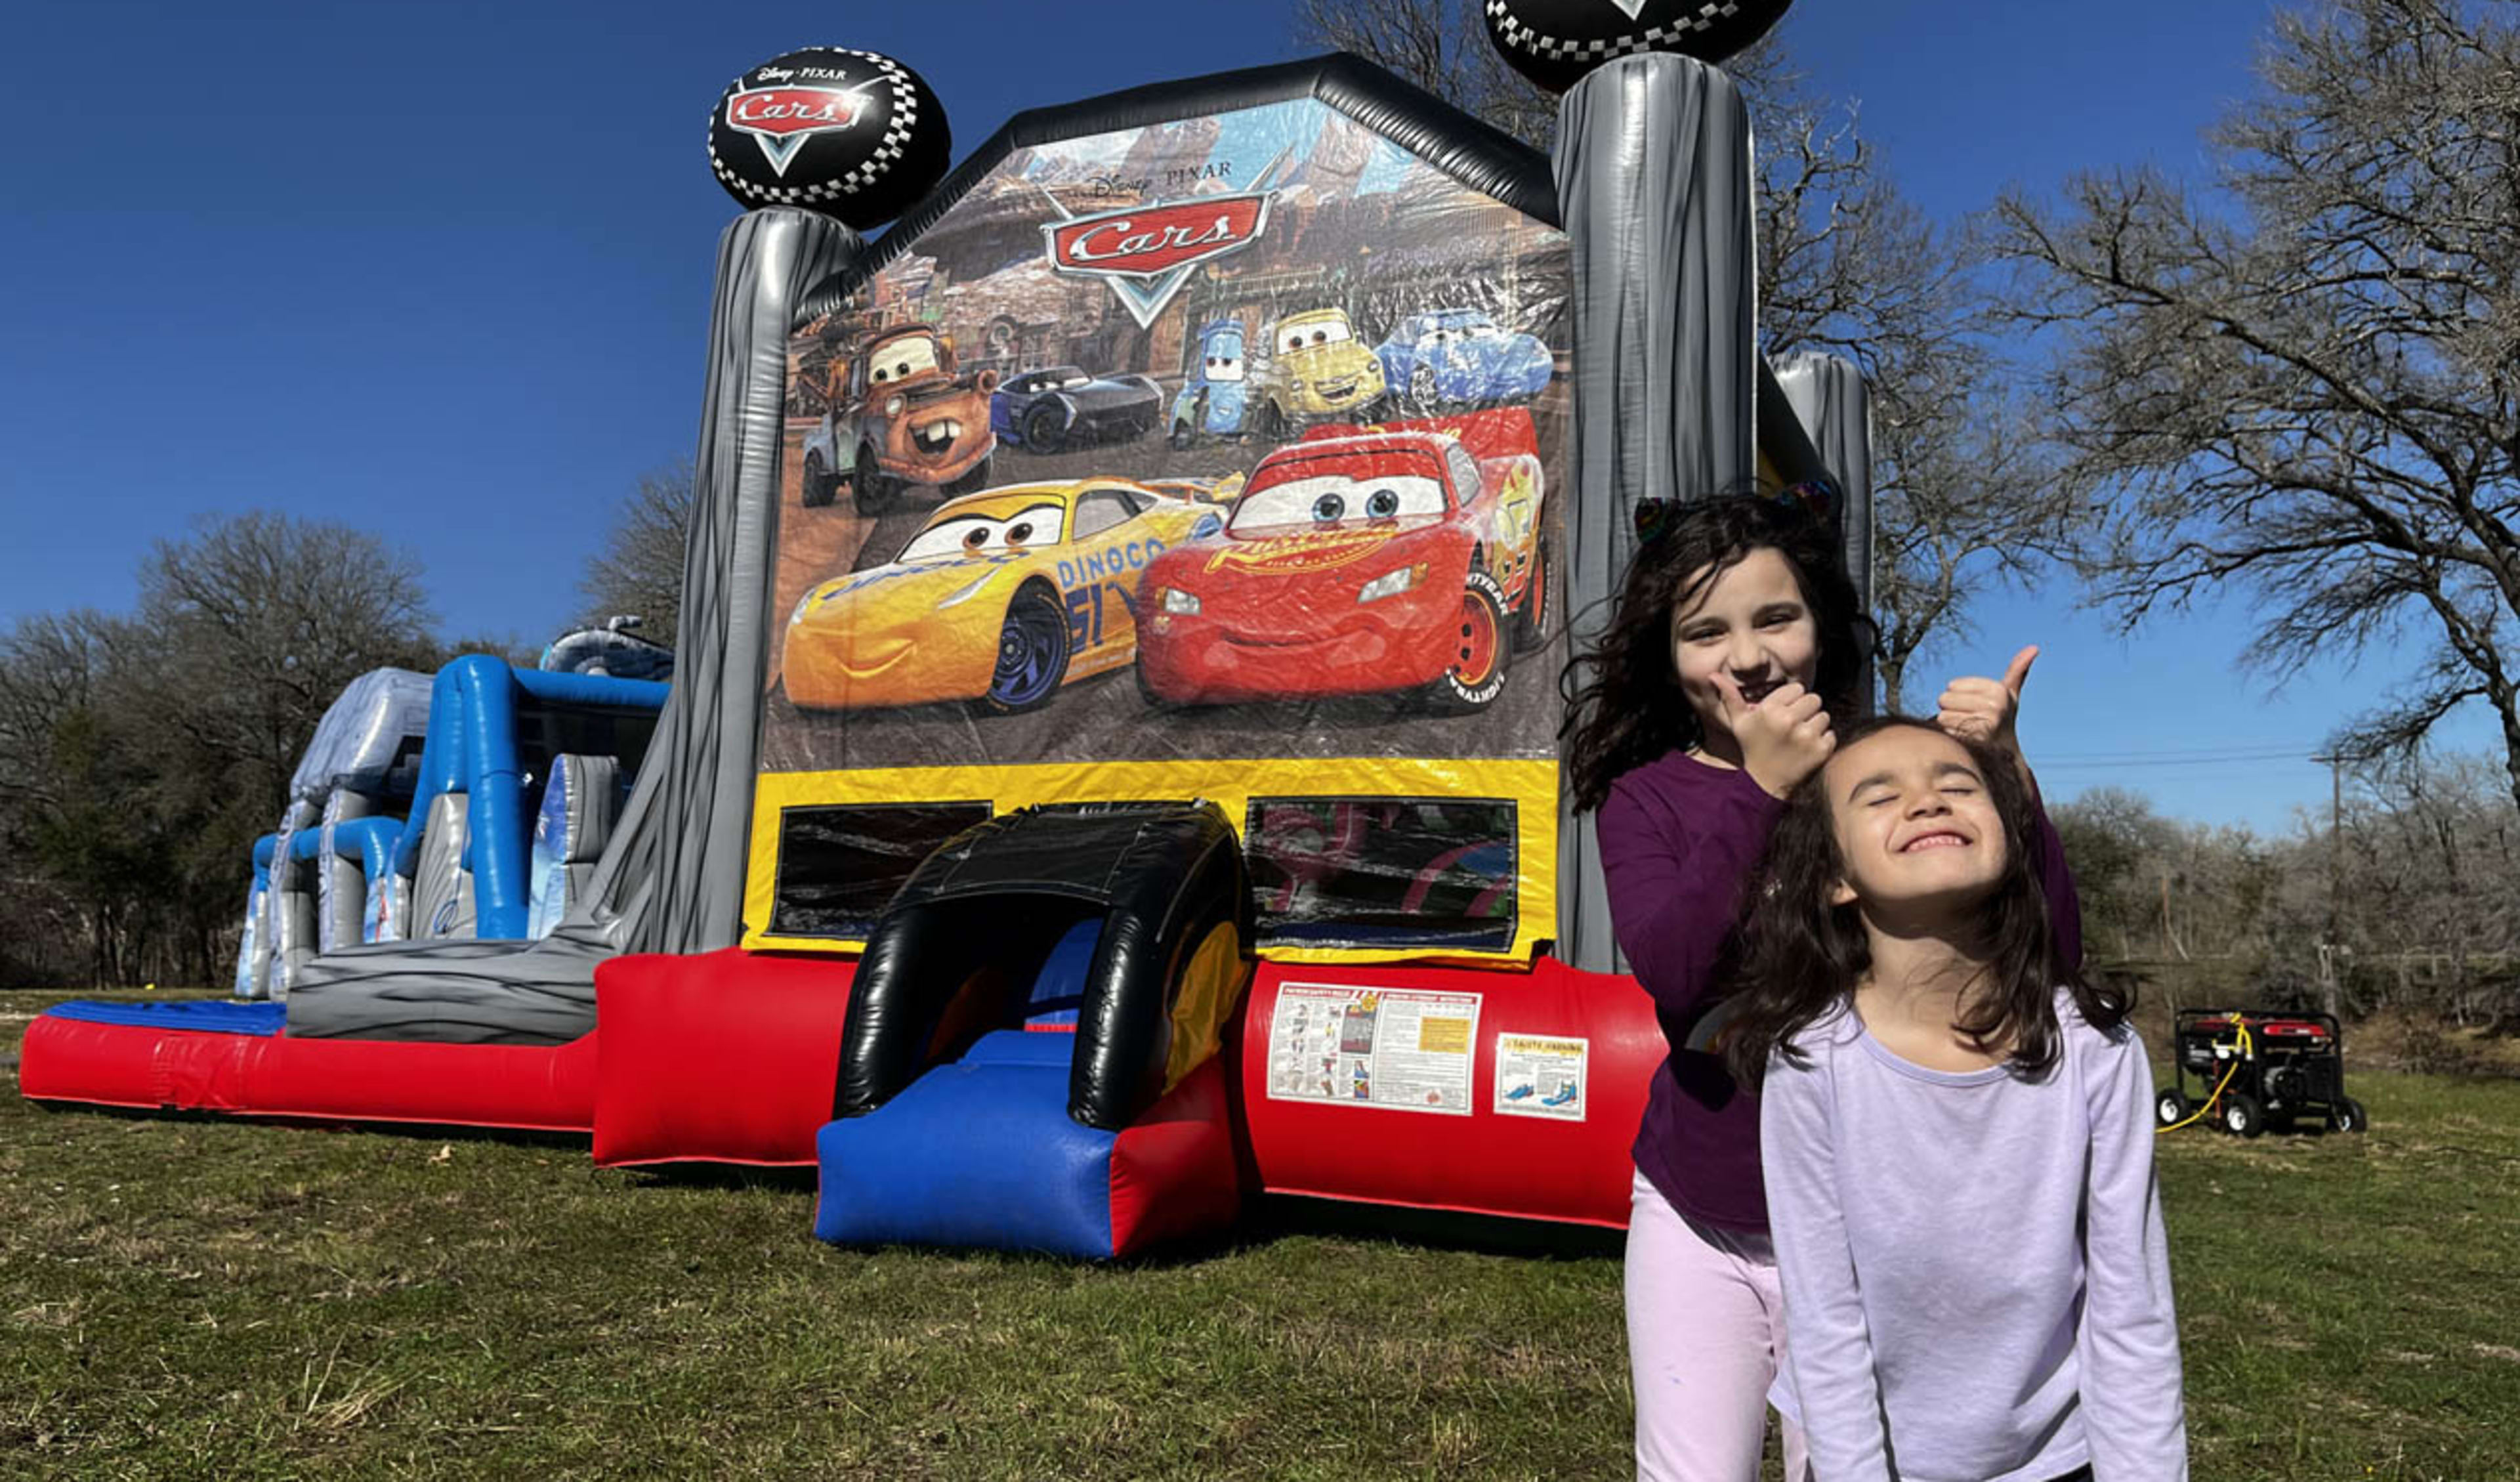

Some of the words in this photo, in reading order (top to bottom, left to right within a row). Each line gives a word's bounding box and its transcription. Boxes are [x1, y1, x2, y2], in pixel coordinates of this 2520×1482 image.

[800, 67, 847, 81] PIXAR
[736, 94, 840, 123] Cars
[1085, 174, 1152, 198] Disney
[1166, 161, 1232, 186] PIXAR
[1069, 215, 1238, 261] Cars
